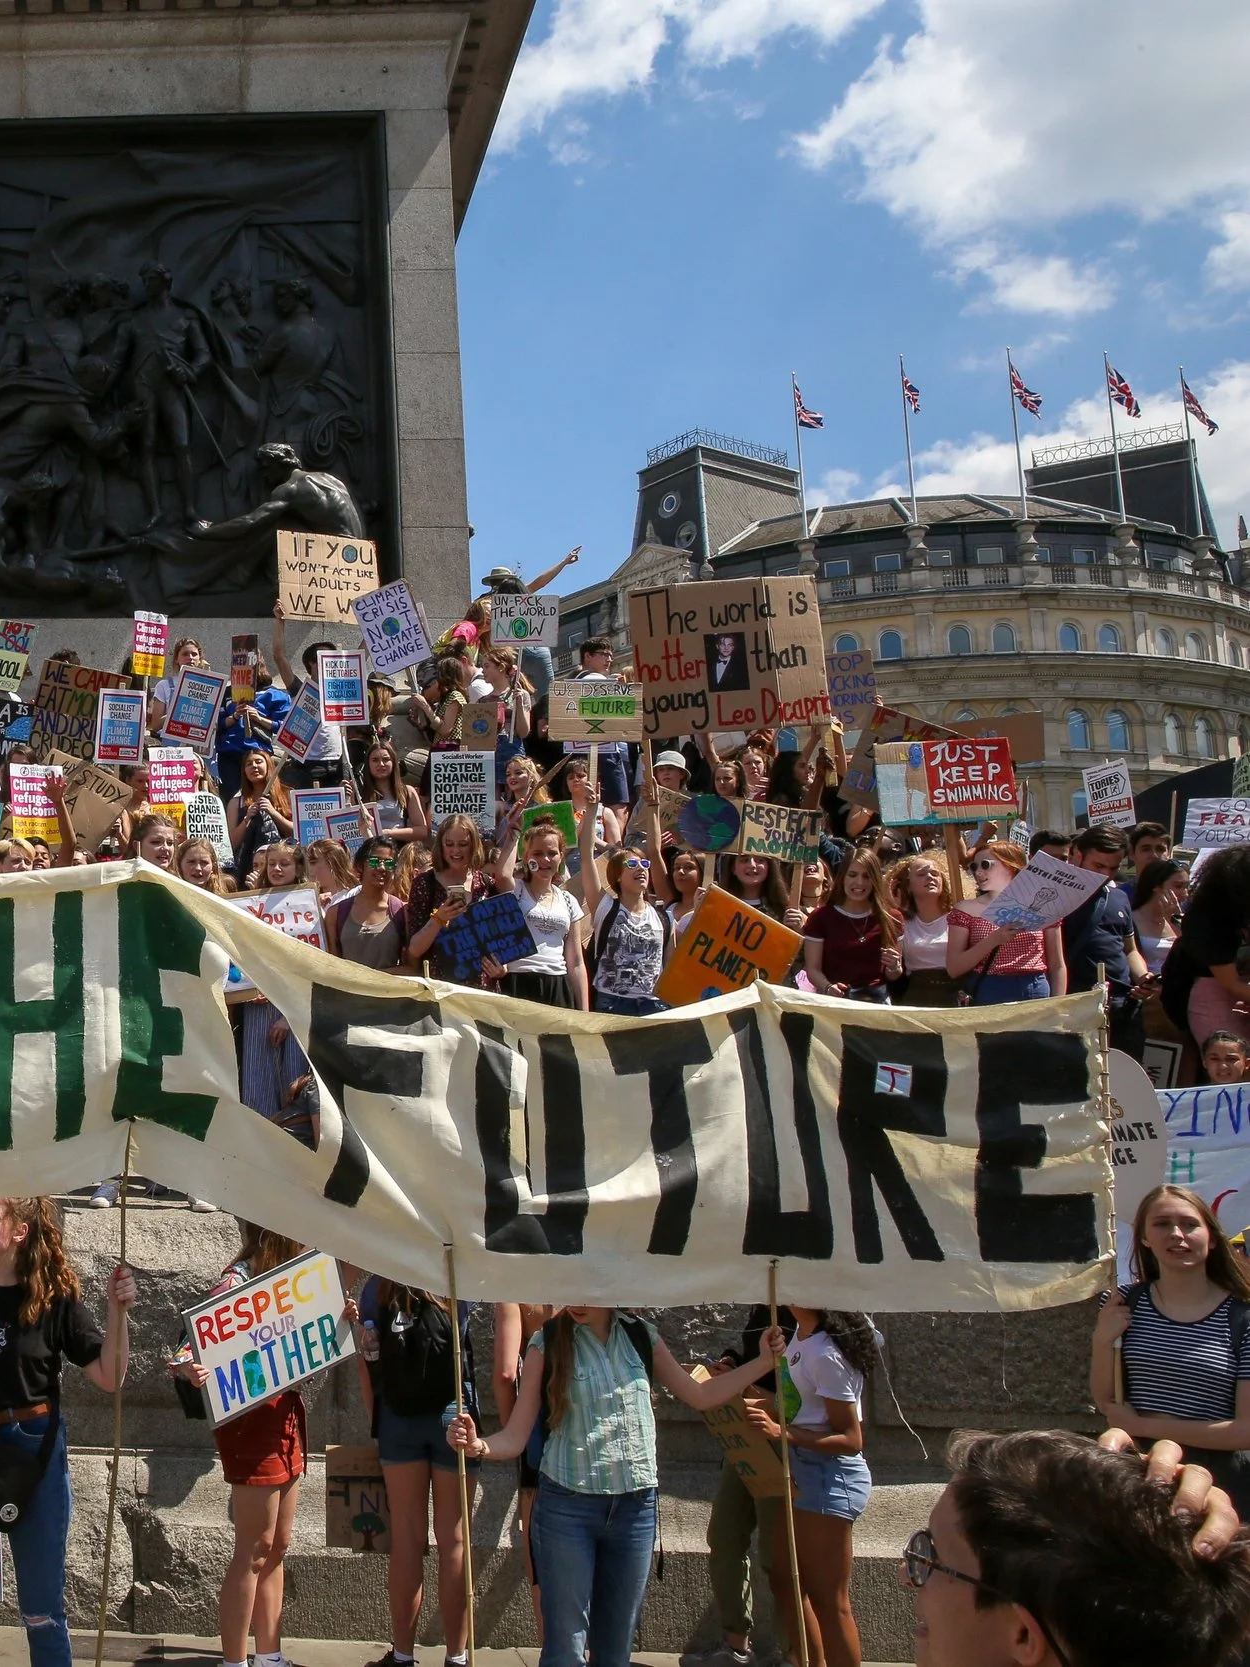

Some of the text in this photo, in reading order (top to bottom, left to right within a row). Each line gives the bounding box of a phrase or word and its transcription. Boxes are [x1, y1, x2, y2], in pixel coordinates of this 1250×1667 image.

[294, 537, 373, 565] IF YOU
[286, 561, 352, 576] WON'T ACT
[308, 577, 361, 591] ADULTS
[289, 593, 325, 613] WE
[356, 584, 407, 611] CLIMATE
[362, 597, 407, 623] CRISIS
[492, 607, 556, 619] THE WORLD
[631, 585, 808, 637] The world is
[5, 621, 35, 637] HOT
[137, 622, 161, 635] Climate
[367, 610, 411, 644] NOT
[496, 617, 545, 639] NOW
[136, 634, 165, 646] refugees
[371, 624, 422, 654] CLIMATE
[136, 644, 164, 654] welcome
[376, 639, 423, 666] CHANGE
[635, 630, 807, 683] hotter than
[45, 662, 72, 684] WE
[338, 669, 357, 677] TORIES
[188, 681, 214, 693] SOCIALIST
[328, 690, 357, 698] SOCIALISM
[553, 683, 635, 697] WE DESERVE
[35, 684, 71, 713] EAT
[188, 690, 209, 701] CHANGE
[16, 704, 28, 715] IS
[109, 704, 135, 712] SOCIALIST
[182, 704, 207, 716] CLIMATE
[566, 701, 635, 714] A FUTURE
[643, 689, 709, 733] young
[717, 695, 756, 726] Leo
[32, 710, 69, 735] AND
[110, 712, 132, 720] CHANGE
[107, 727, 132, 736] CLIMATE
[930, 741, 998, 766] JUST
[151, 764, 186, 776] Climate
[434, 763, 482, 772] SYSTEM
[939, 763, 1000, 786] KEEP
[152, 777, 192, 791] refugees
[434, 773, 485, 783] CHANGE
[1090, 774, 1119, 791] TORIES
[75, 769, 127, 804] STUDY
[435, 784, 459, 793] NOT
[933, 783, 1012, 803] SWIMMING
[434, 794, 487, 803] CLIMATE
[1092, 788, 1108, 800] OUT
[188, 805, 220, 814] CHANGE
[305, 803, 333, 811] SOCIALIST
[434, 804, 485, 813] CHANGE
[1092, 801, 1119, 811] CORBYN
[1220, 800, 1247, 812] GO
[189, 815, 206, 823] NOT
[744, 804, 822, 836] RESPECT
[190, 824, 223, 833] CLIMATE
[764, 828, 805, 845] YOUR
[1026, 864, 1062, 884] NOTHING
[725, 911, 766, 950] NO
[689, 932, 759, 985] PLANET
[310, 982, 1100, 1264] FUTURE
[196, 1259, 330, 1350] RESPECT
[248, 1315, 296, 1346] YOUR
[214, 1314, 341, 1412] MOTHER
